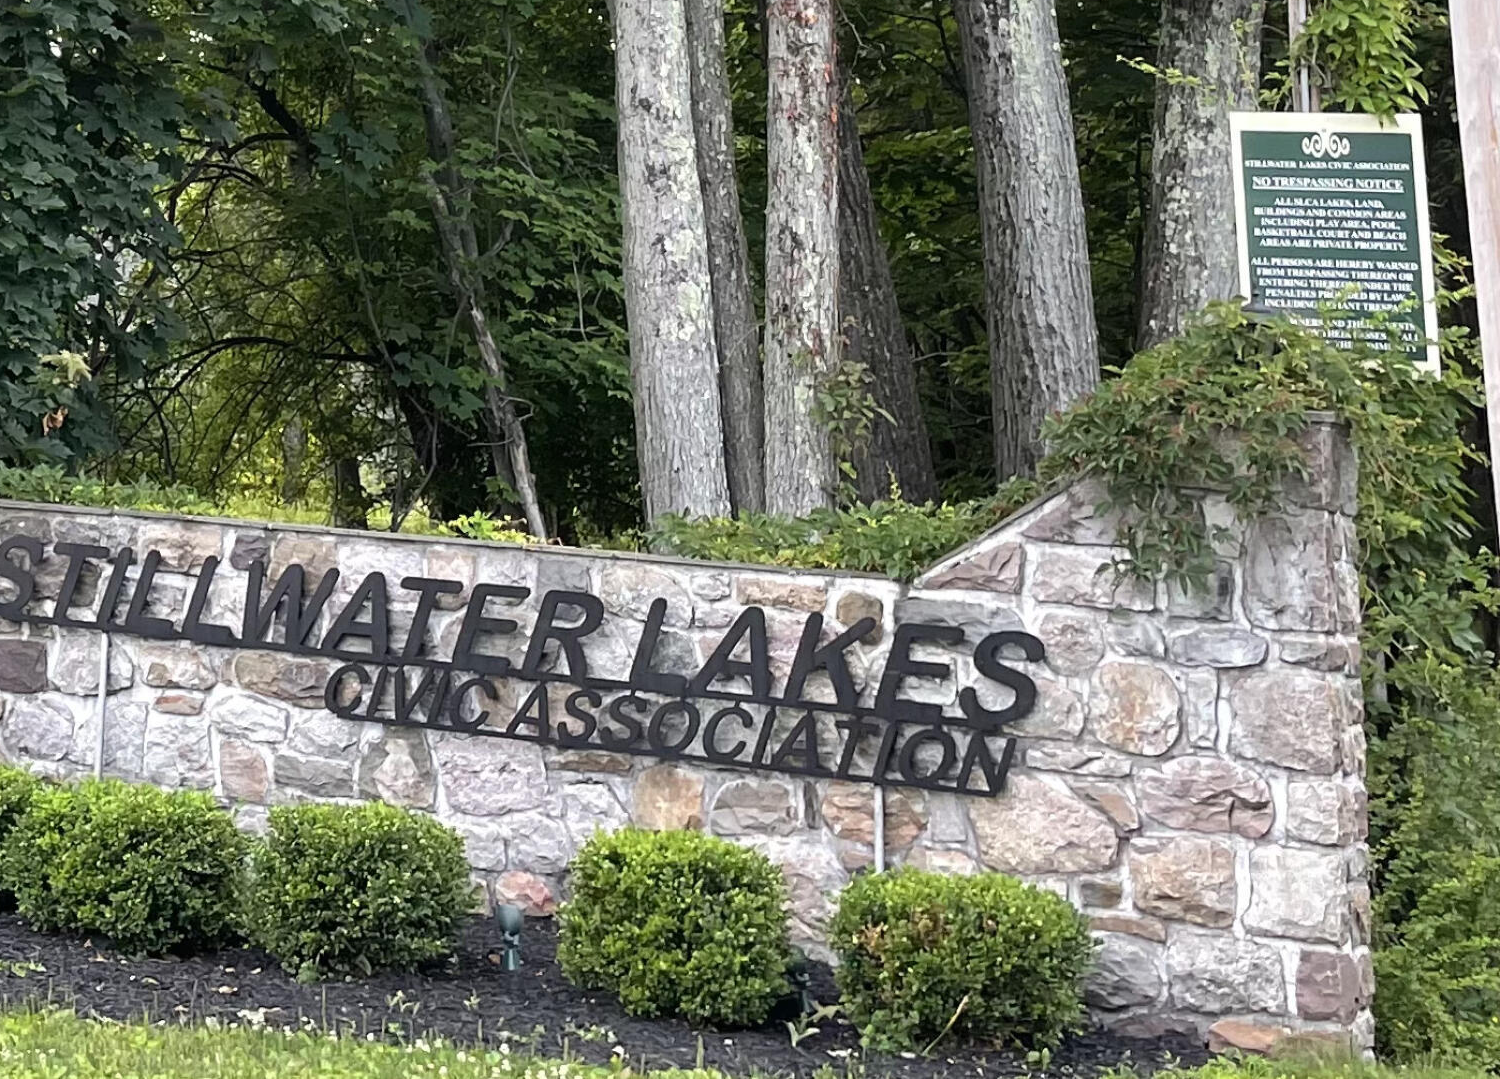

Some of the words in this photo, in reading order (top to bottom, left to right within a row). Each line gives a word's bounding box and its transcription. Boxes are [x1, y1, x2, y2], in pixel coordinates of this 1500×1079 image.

[1252, 176, 1271, 187] NO
[1272, 177, 1353, 189] TRESPASSING
[1355, 178, 1404, 190] NOTICE
[1274, 197, 1293, 207] ALL
[1254, 207, 1304, 217] BUILDINGS
[1306, 208, 1326, 218] AND
[1327, 209, 1373, 219] COMMON
[1375, 210, 1407, 220] AREAS
[1261, 217, 1314, 228] INCLUDING
[1315, 219, 1339, 228] PLAY
[1254, 227, 1316, 238] BASKETBALL
[1316, 229, 1350, 239] COURT
[1351, 230, 1371, 240] AND
[1372, 231, 1407, 241] BEACH
[1260, 238, 1291, 247] AREAS
[1292, 239, 1311, 248] ARE
[1313, 240, 1353, 249] PRIVATE
[1251, 257, 1270, 266] ALL
[1271, 257, 1313, 267] PERSONS
[1314, 259, 1335, 268] ARE
[1336, 259, 1375, 270] HEREBY
[1376, 261, 1419, 271] WARNED
[1256, 267, 1285, 277] FROM
[1287, 268, 1350, 279] TRESPASSING
[1398, 272, 1414, 282] OR
[1259, 278, 1308, 288] ENTERING
[1265, 288, 1317, 298] PENALTIES
[1369, 292, 1382, 301] BY
[631, 598, 1045, 723] LAKES
[325, 664, 498, 729] CIVIC
[507, 685, 1017, 796] ASSOCIATION
